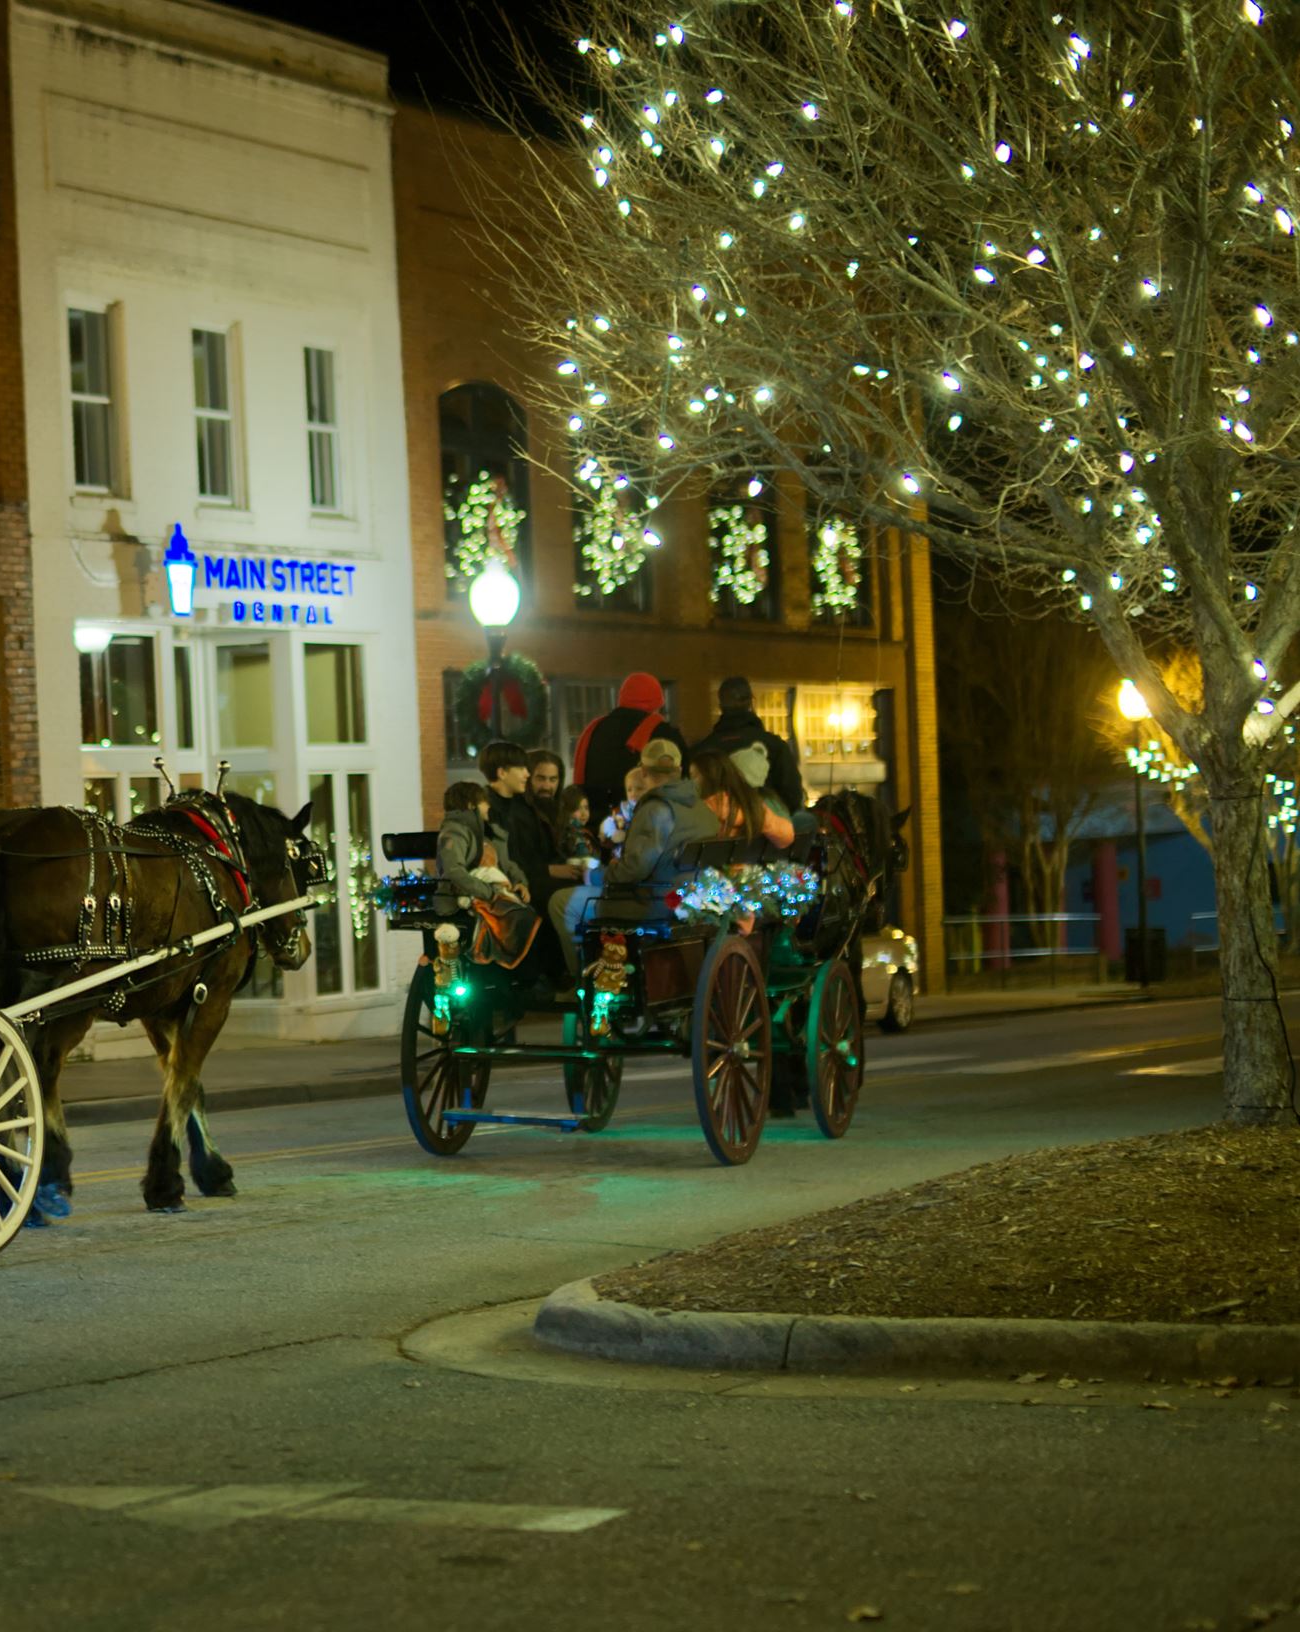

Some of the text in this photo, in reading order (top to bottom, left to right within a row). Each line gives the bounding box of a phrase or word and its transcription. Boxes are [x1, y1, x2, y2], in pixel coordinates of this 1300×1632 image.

[205, 556, 355, 596] MAIN STREET
[233, 601, 333, 624] DENTAL
